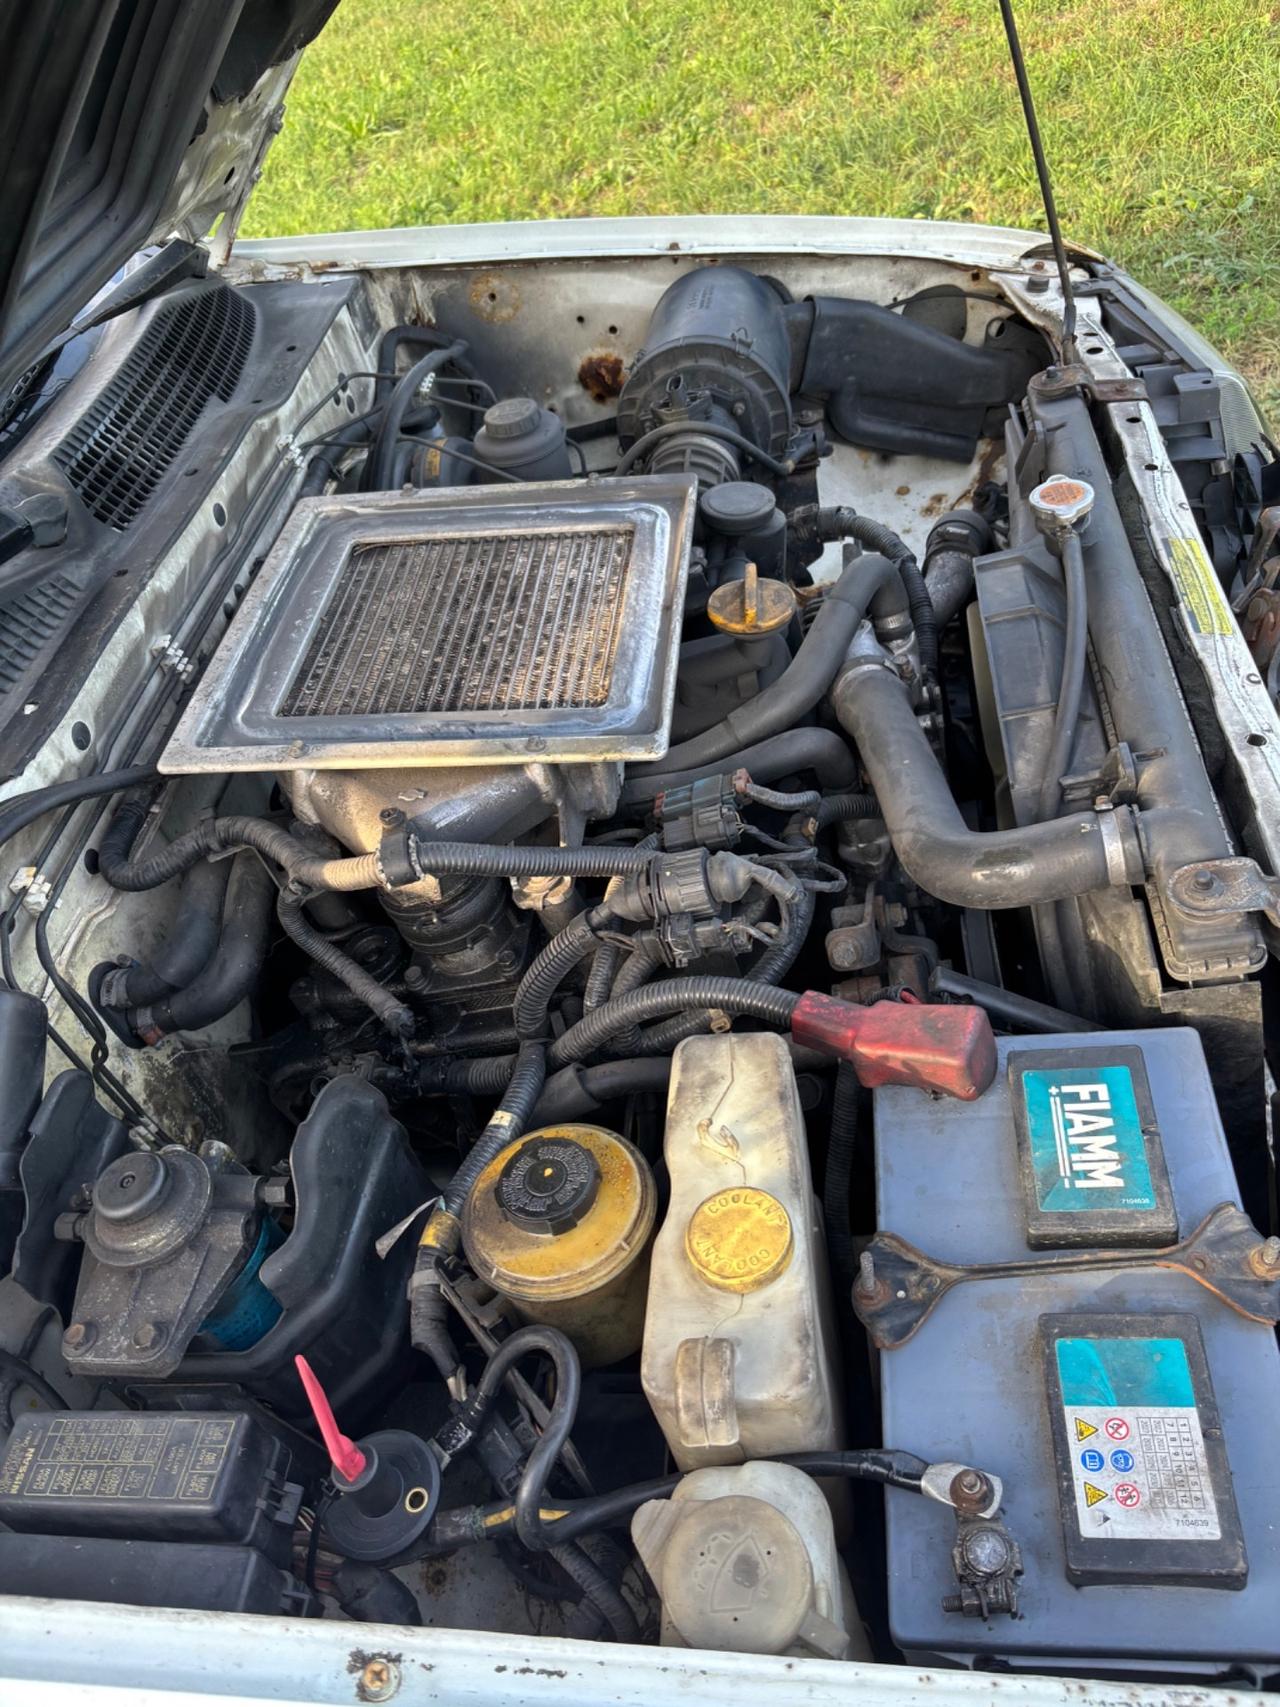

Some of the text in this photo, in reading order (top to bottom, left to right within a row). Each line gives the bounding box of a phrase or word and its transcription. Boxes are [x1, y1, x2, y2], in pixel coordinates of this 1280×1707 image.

[1060, 1083, 1125, 1189] FIAMM
[707, 1193, 788, 1225] COOLANT
[696, 1239, 770, 1271] COOLANT
[10, 1447, 35, 1494] NISSAN
[1175, 1464, 1183, 1473] 10
[1180, 1495, 1188, 1504] 12
